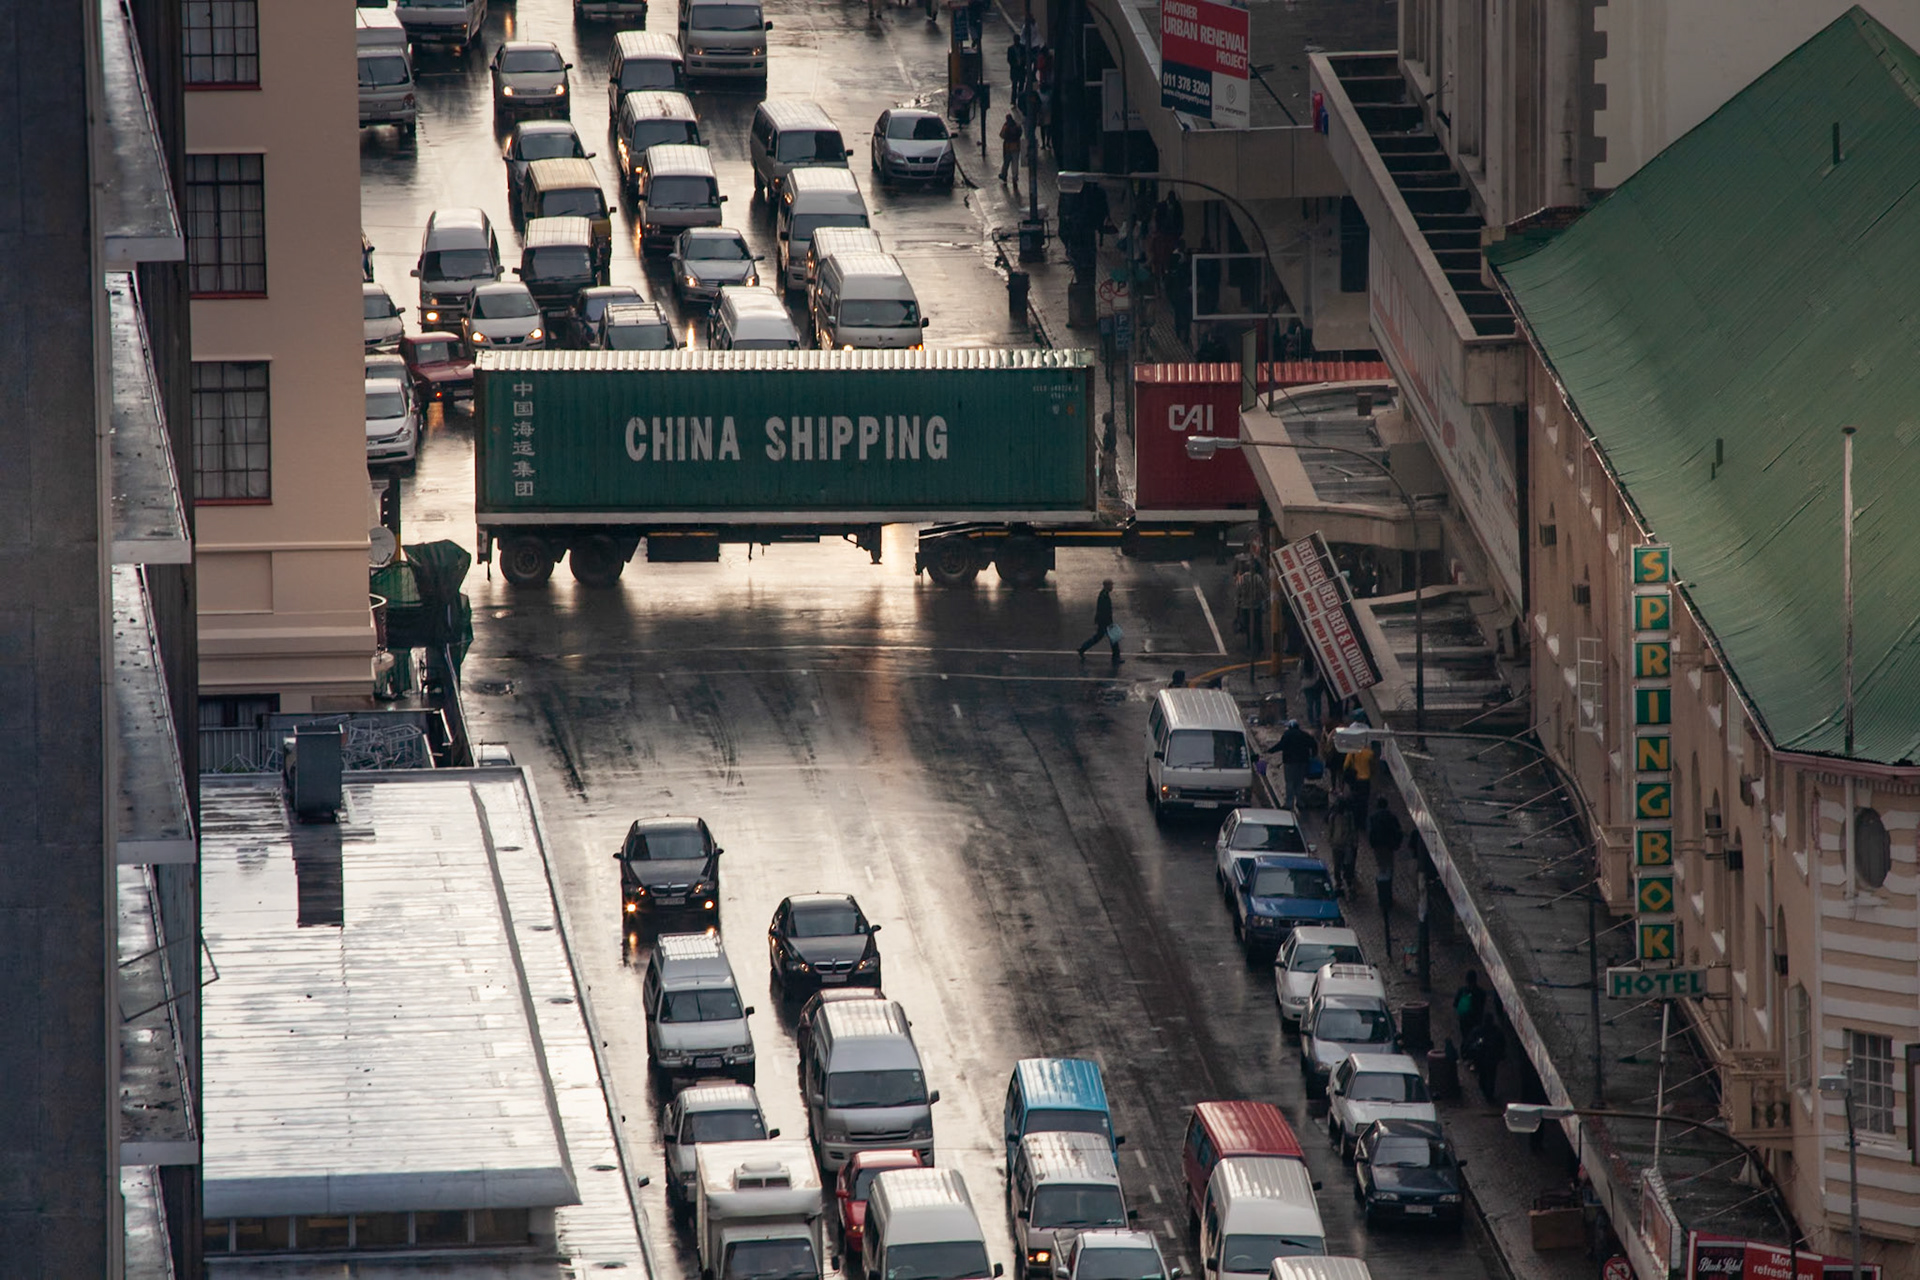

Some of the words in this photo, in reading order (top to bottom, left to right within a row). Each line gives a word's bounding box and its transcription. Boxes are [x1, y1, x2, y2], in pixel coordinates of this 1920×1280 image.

[1164, 0, 1198, 20] ANOTHER
[1163, 17, 1198, 41] URBAN
[1200, 25, 1247, 54] RENEWAL
[1216, 50, 1247, 70] PROJECT
[1163, 72, 1177, 87] 011
[1177, 75, 1191, 92] 378
[1192, 79, 1210, 97] 3200
[1119, 315, 1127, 325] P
[1168, 404, 1214, 432] CAI
[512, 380, 536, 497] 中国海运集团
[625, 415, 741, 462] CHINA
[765, 414, 949, 462] SHIPPING
[1317, 584, 1337, 608] BED
[1327, 610, 1346, 633] BED
[1312, 618, 1326, 638] OPEN
[1323, 644, 1337, 663] DAYS
[1337, 631, 1352, 645] &
[1342, 643, 1371, 686] LOUNGE
[1639, 551, 1672, 958] SPRINGBOK
[1613, 973, 1702, 997] HOTEL
[1698, 1257, 1723, 1273] Black
[1722, 1256, 1743, 1275] Label
[1772, 1254, 1793, 1266] Mor
[1753, 1265, 1814, 1280] refreshent
